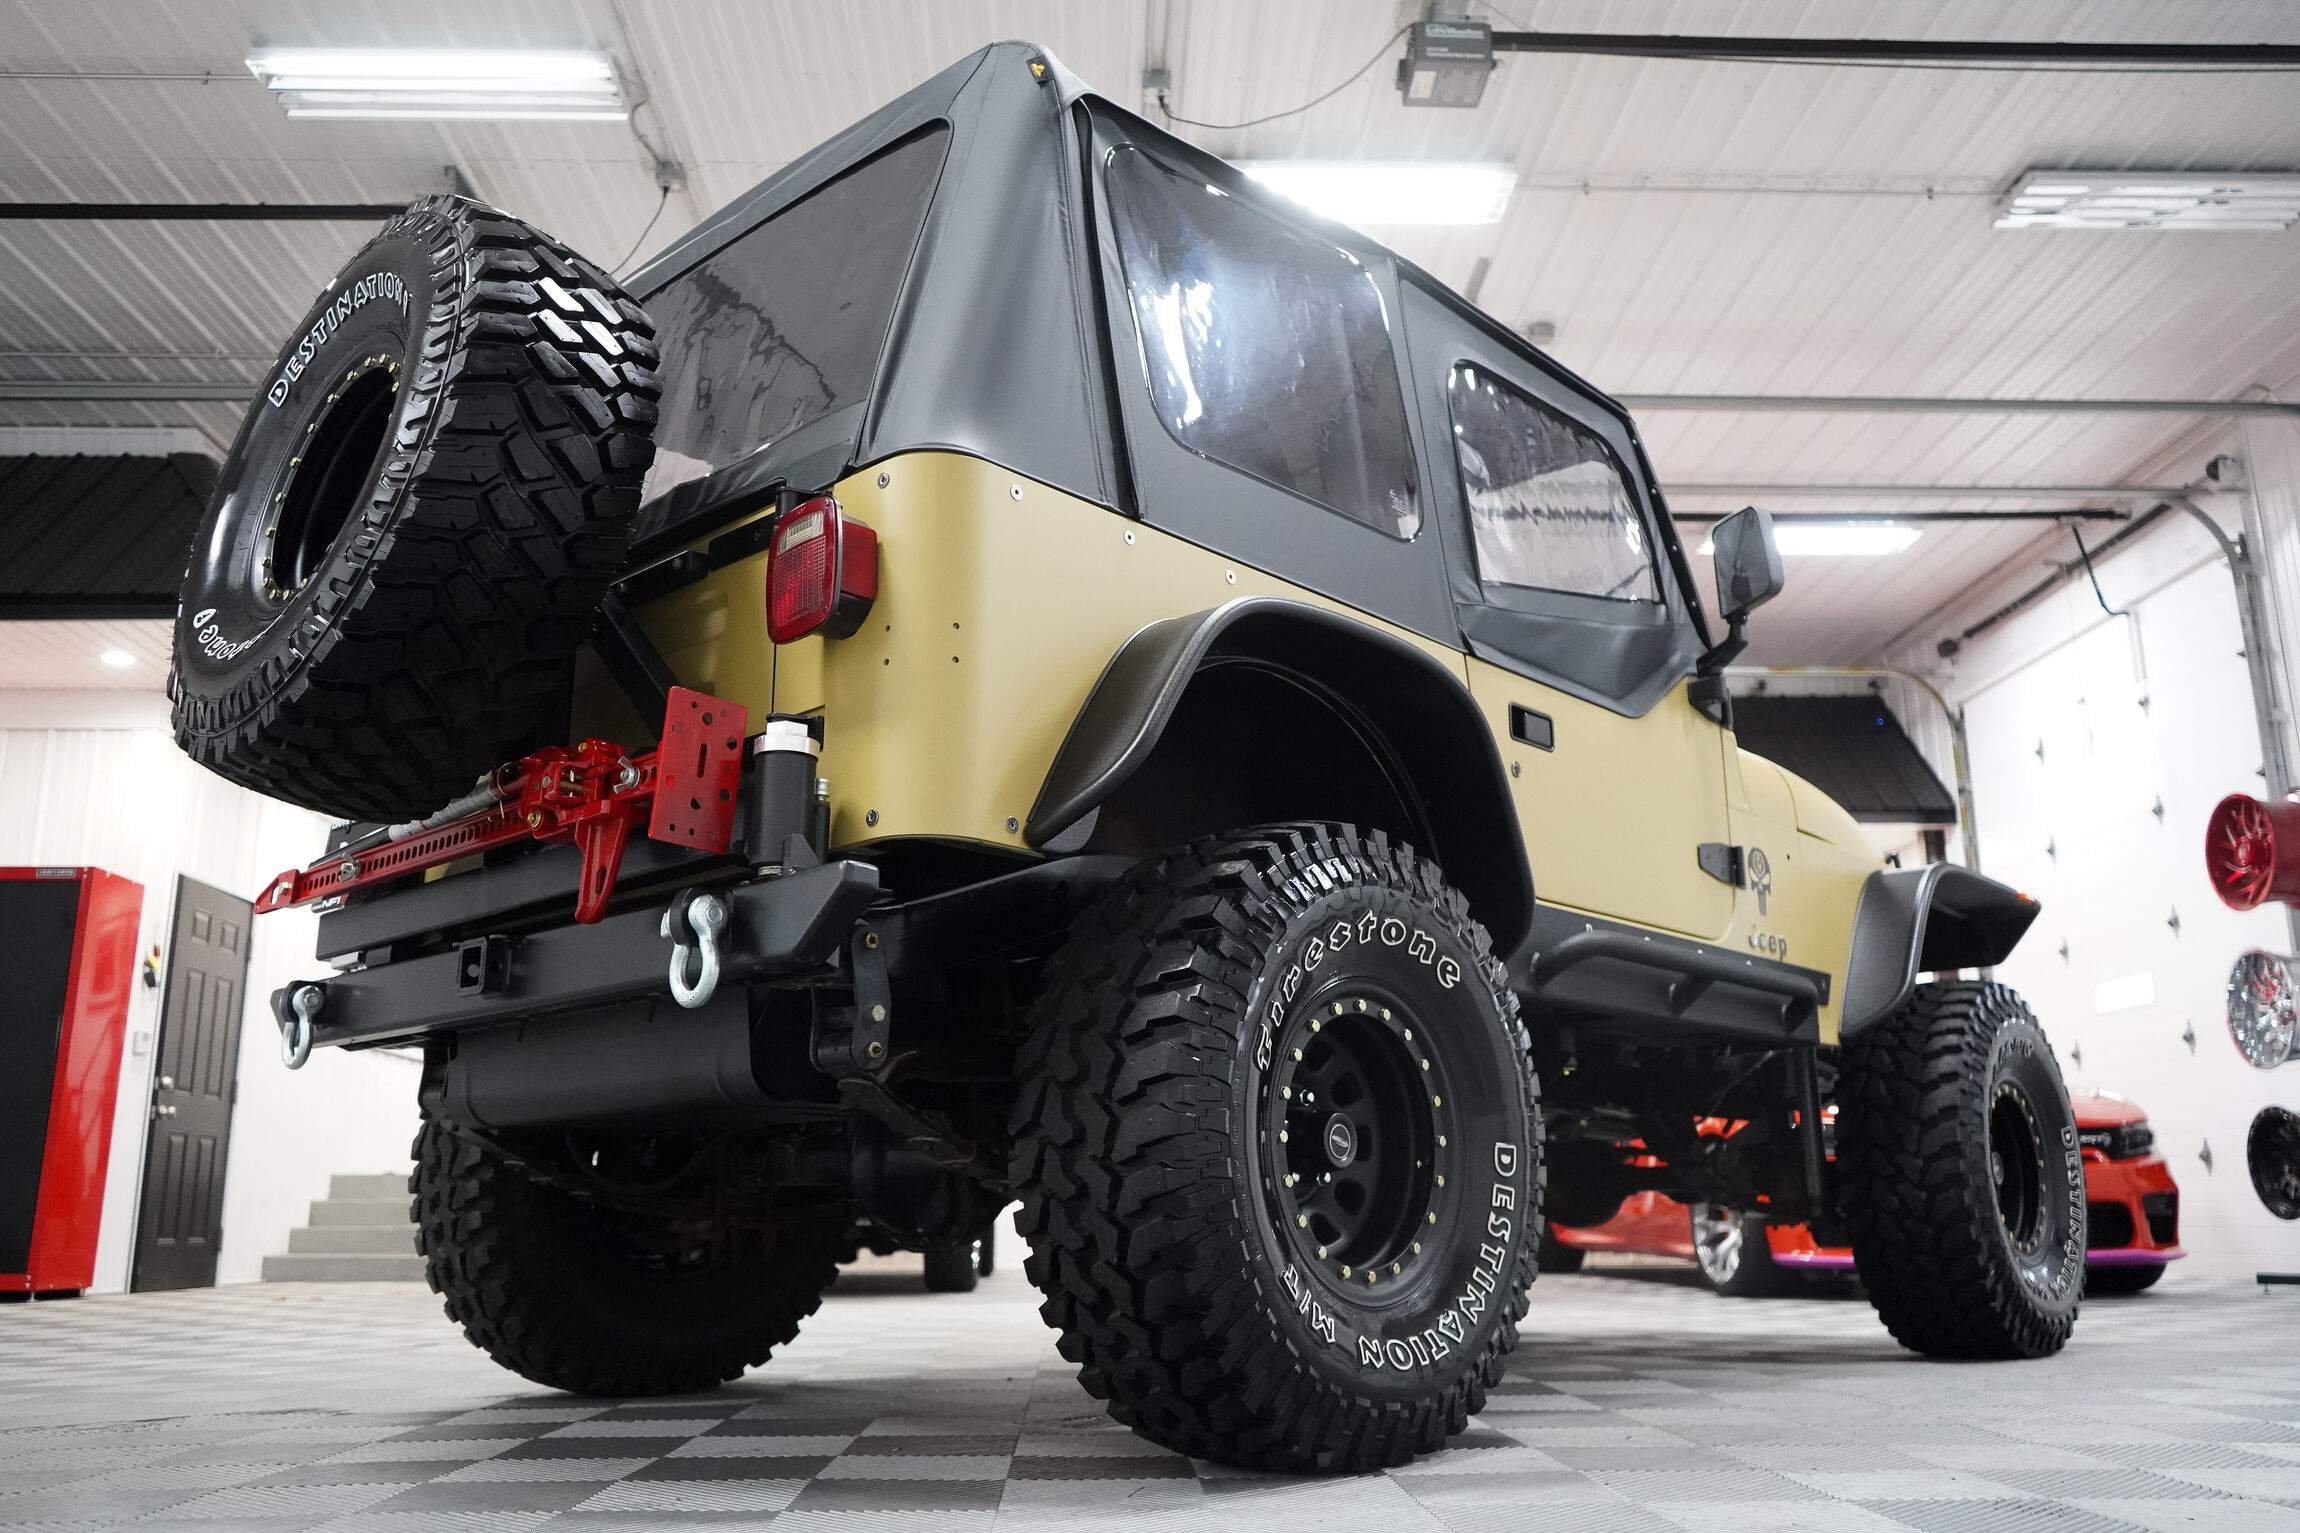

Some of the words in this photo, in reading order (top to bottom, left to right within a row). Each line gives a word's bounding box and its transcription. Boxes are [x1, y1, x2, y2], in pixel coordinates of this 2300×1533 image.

[268, 272, 403, 408] DESTINATION
[1256, 909, 1460, 1071] Firestone
[1748, 923, 1788, 962] Jeep
[1358, 1142, 1517, 1370] DESTINATION
[2050, 1125, 2083, 1300] DESTINATION
